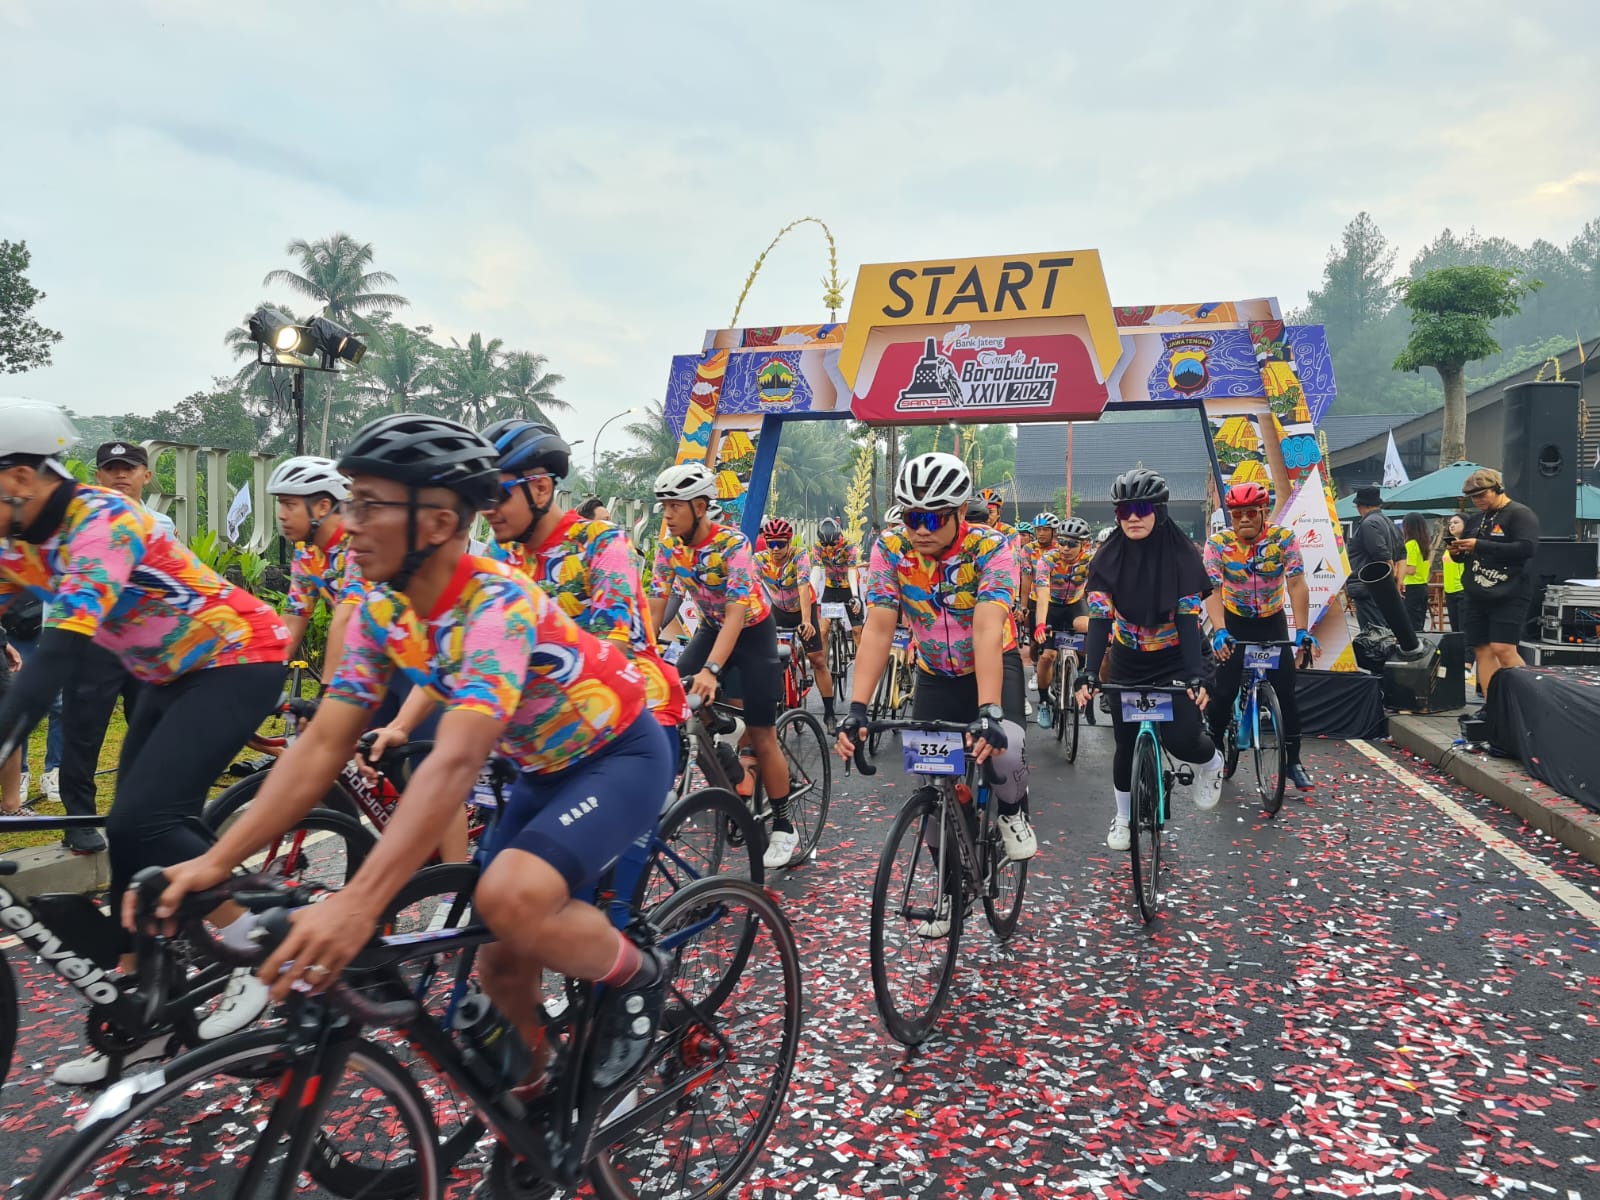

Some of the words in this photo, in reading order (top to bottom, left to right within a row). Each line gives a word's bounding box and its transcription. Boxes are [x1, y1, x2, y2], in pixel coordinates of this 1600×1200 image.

[882, 258, 1074, 318] START
[955, 338, 976, 349] Bank
[977, 337, 1004, 349] Jateng
[1168, 339, 1185, 348] JAWA
[1186, 338, 1211, 347] TENGAH
[980, 352, 1008, 365] Tour
[1010, 350, 1024, 363] de
[962, 359, 1056, 383] Borobudur
[967, 383, 1009, 404] XXIV
[1012, 382, 1049, 400] 2024
[1254, 652, 1270, 660] 160
[1135, 699, 1157, 709] 13
[919, 743, 950, 757] 334
[341, 765, 391, 826] POLYGO
